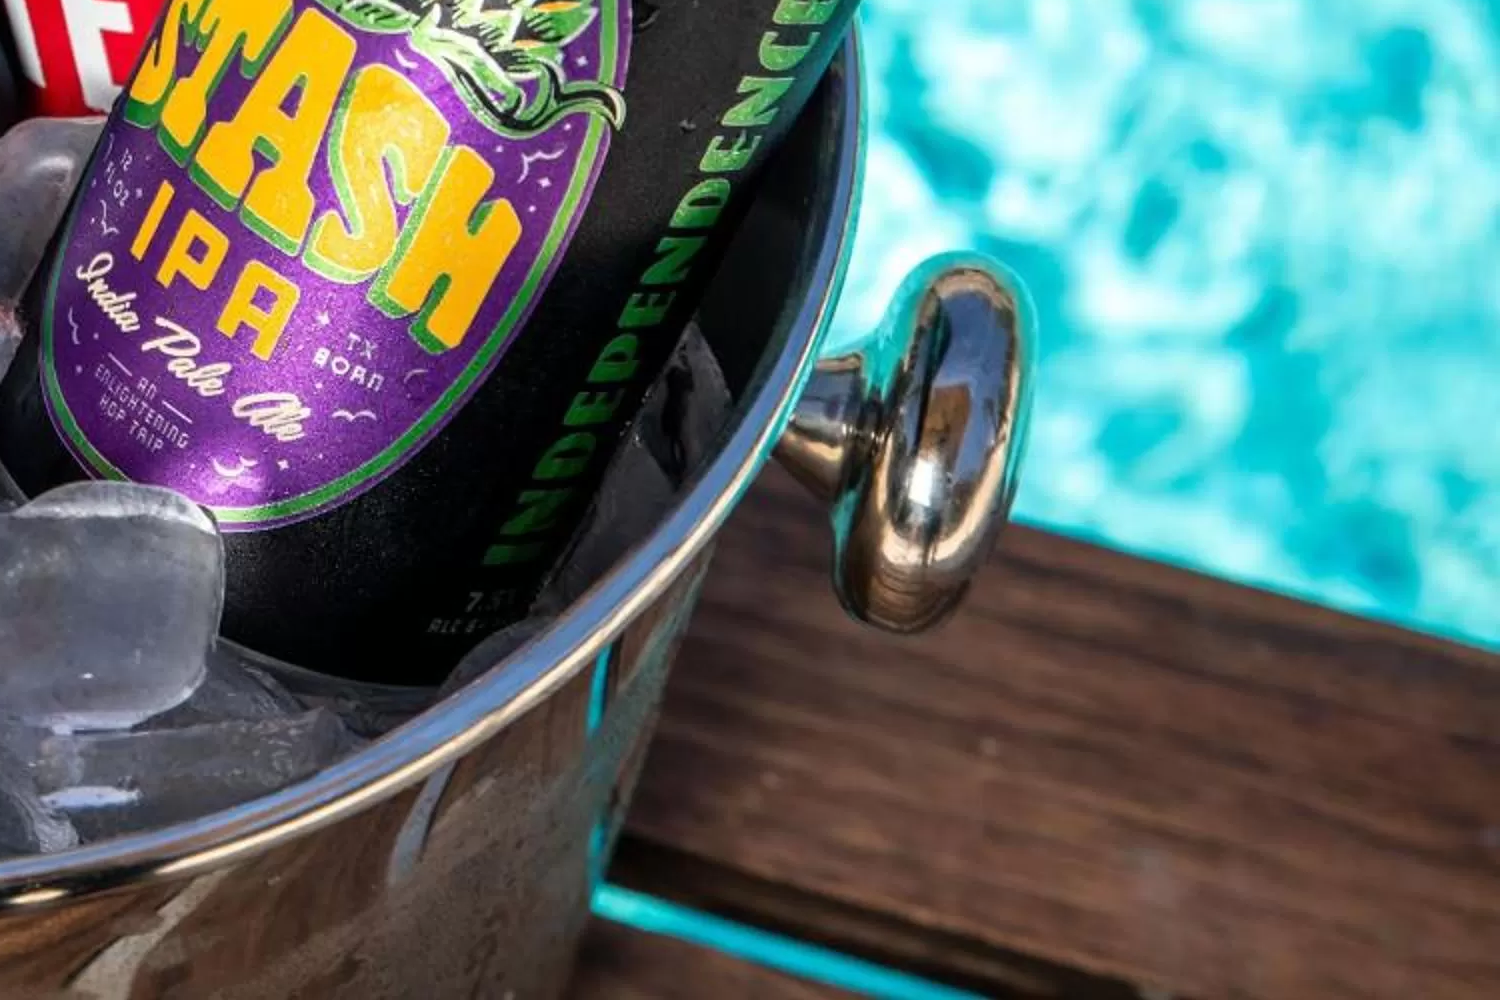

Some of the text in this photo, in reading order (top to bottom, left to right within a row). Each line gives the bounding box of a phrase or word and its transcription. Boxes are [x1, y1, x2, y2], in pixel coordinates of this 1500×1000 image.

[130, 180, 300, 361] IPA
[77, 252, 311, 443] India Pale Ale
[314, 346, 386, 392] BORN
[346, 332, 377, 360] TX
